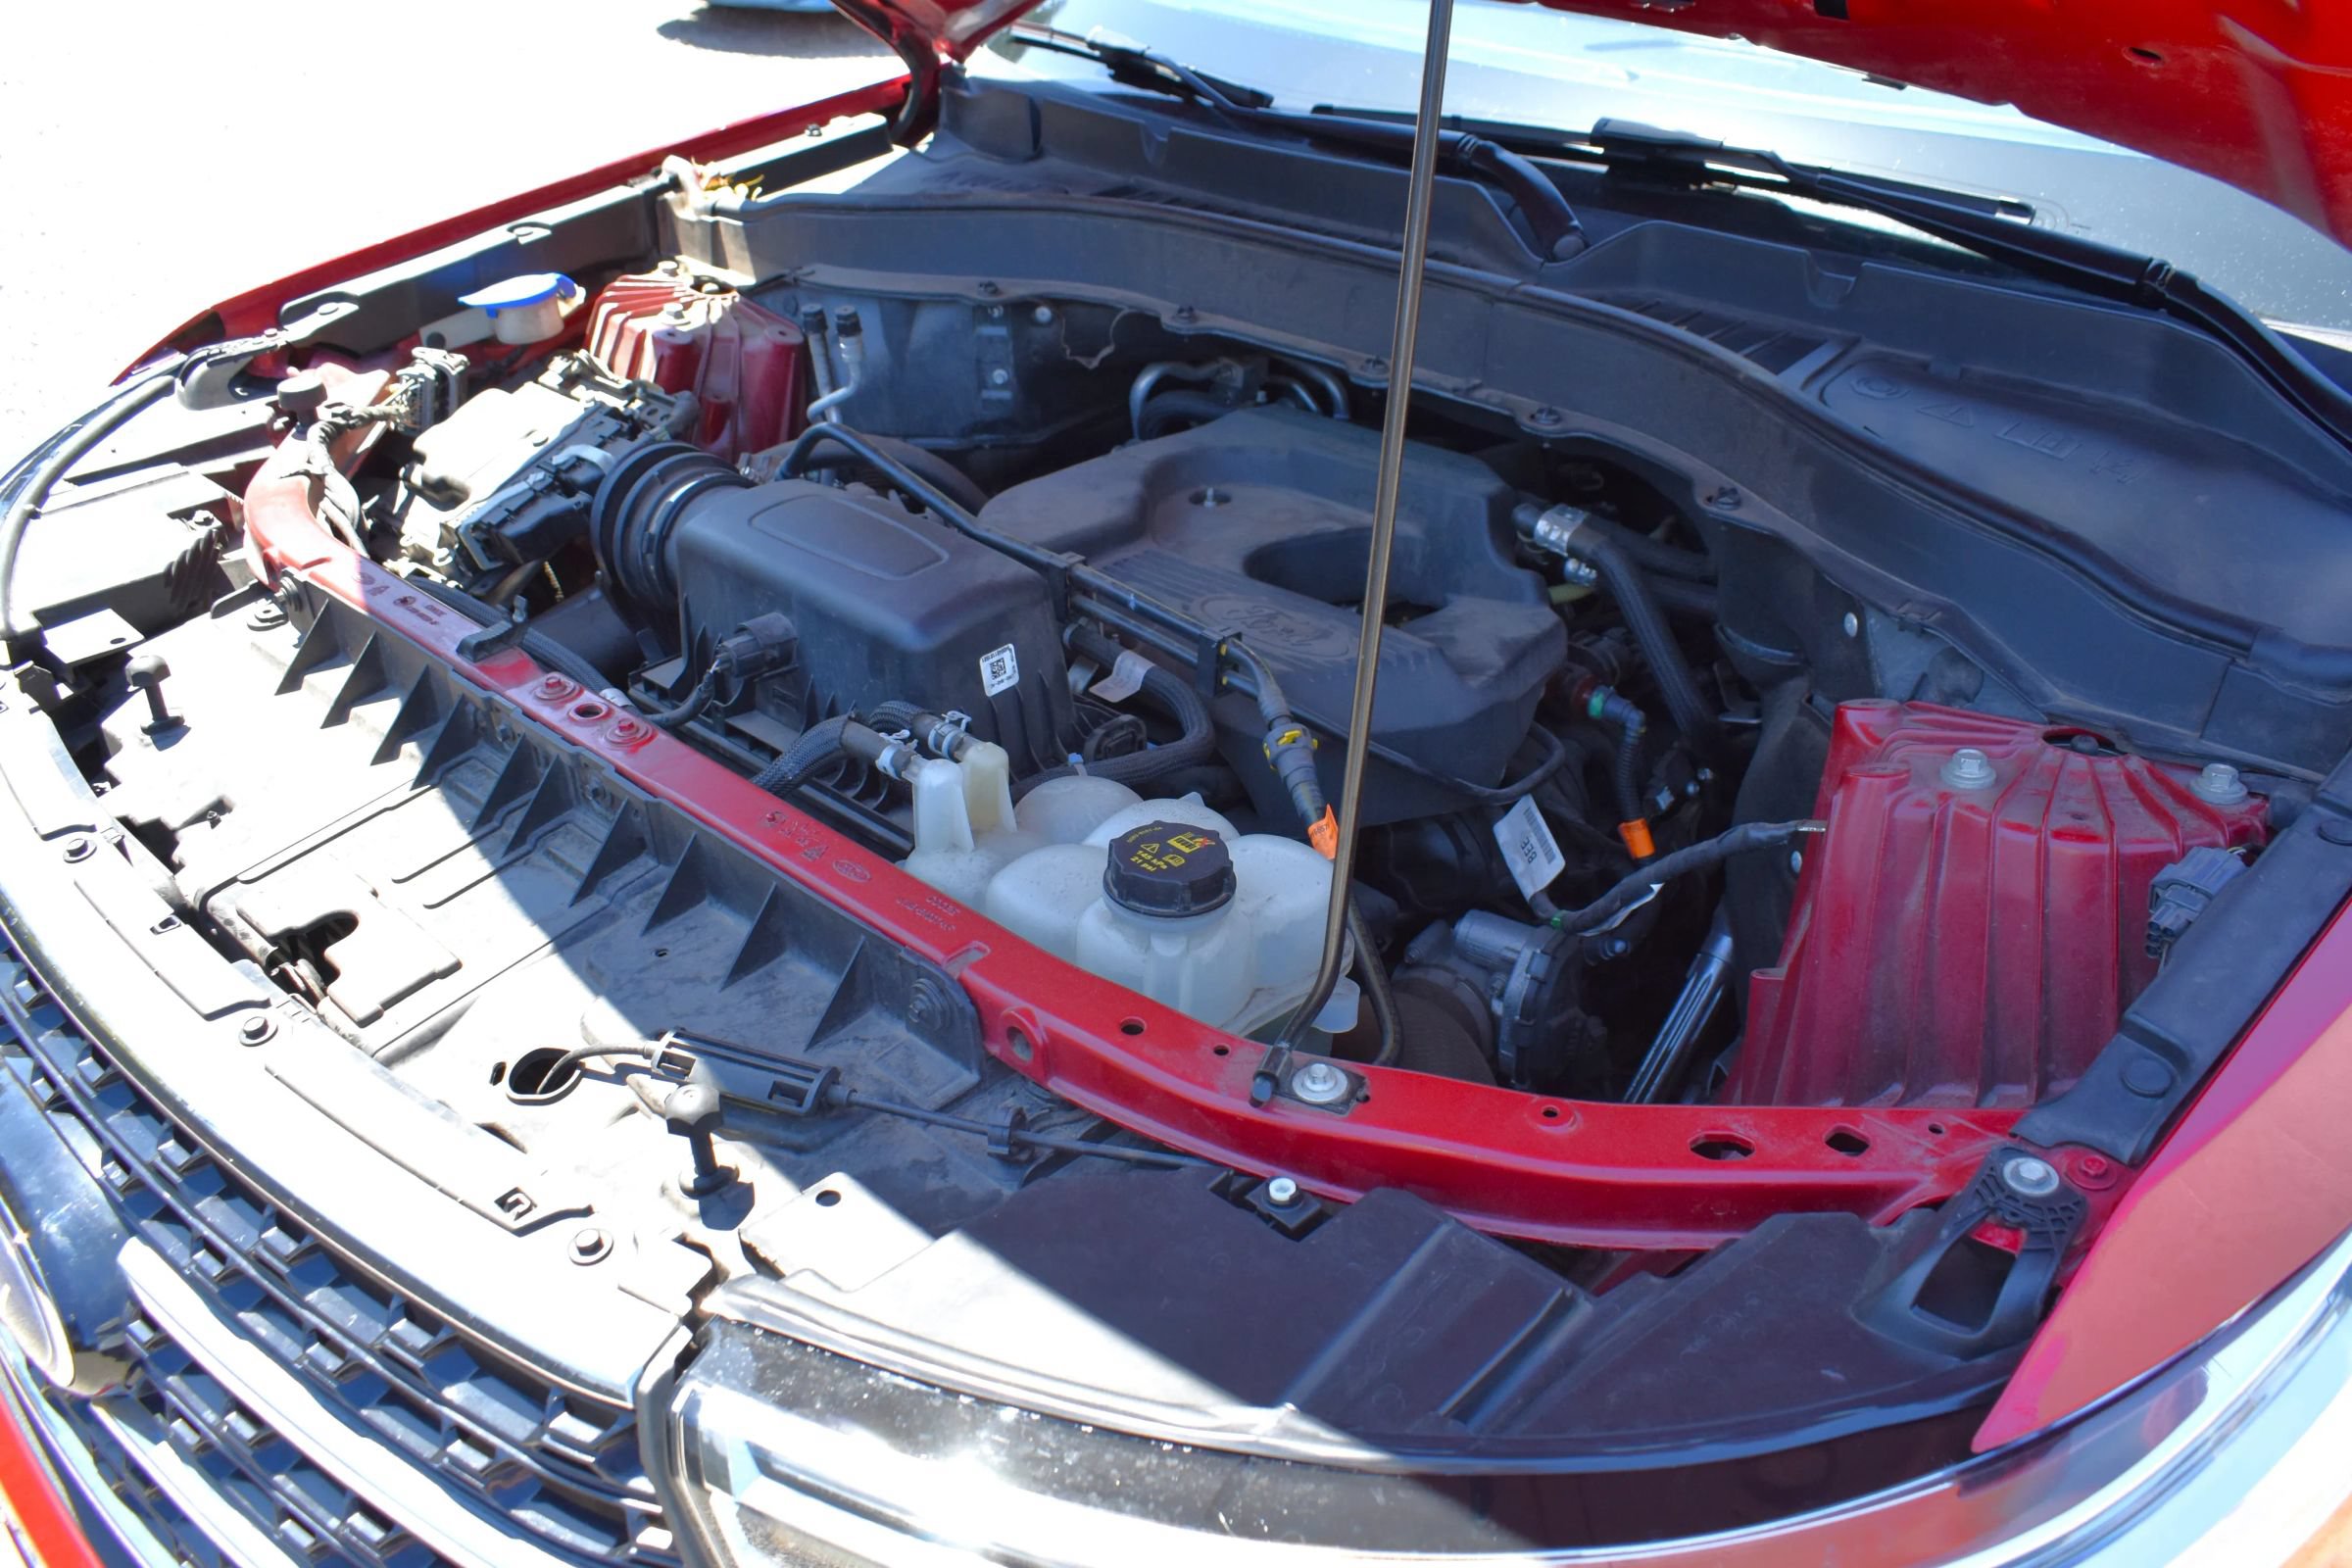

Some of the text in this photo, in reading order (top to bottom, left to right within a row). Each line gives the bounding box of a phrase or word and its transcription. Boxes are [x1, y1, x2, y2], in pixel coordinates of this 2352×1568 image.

[1221, 605, 1334, 647] Ford
[1136, 850, 1168, 869] 145 kPa
[1140, 862, 1157, 872] psi
